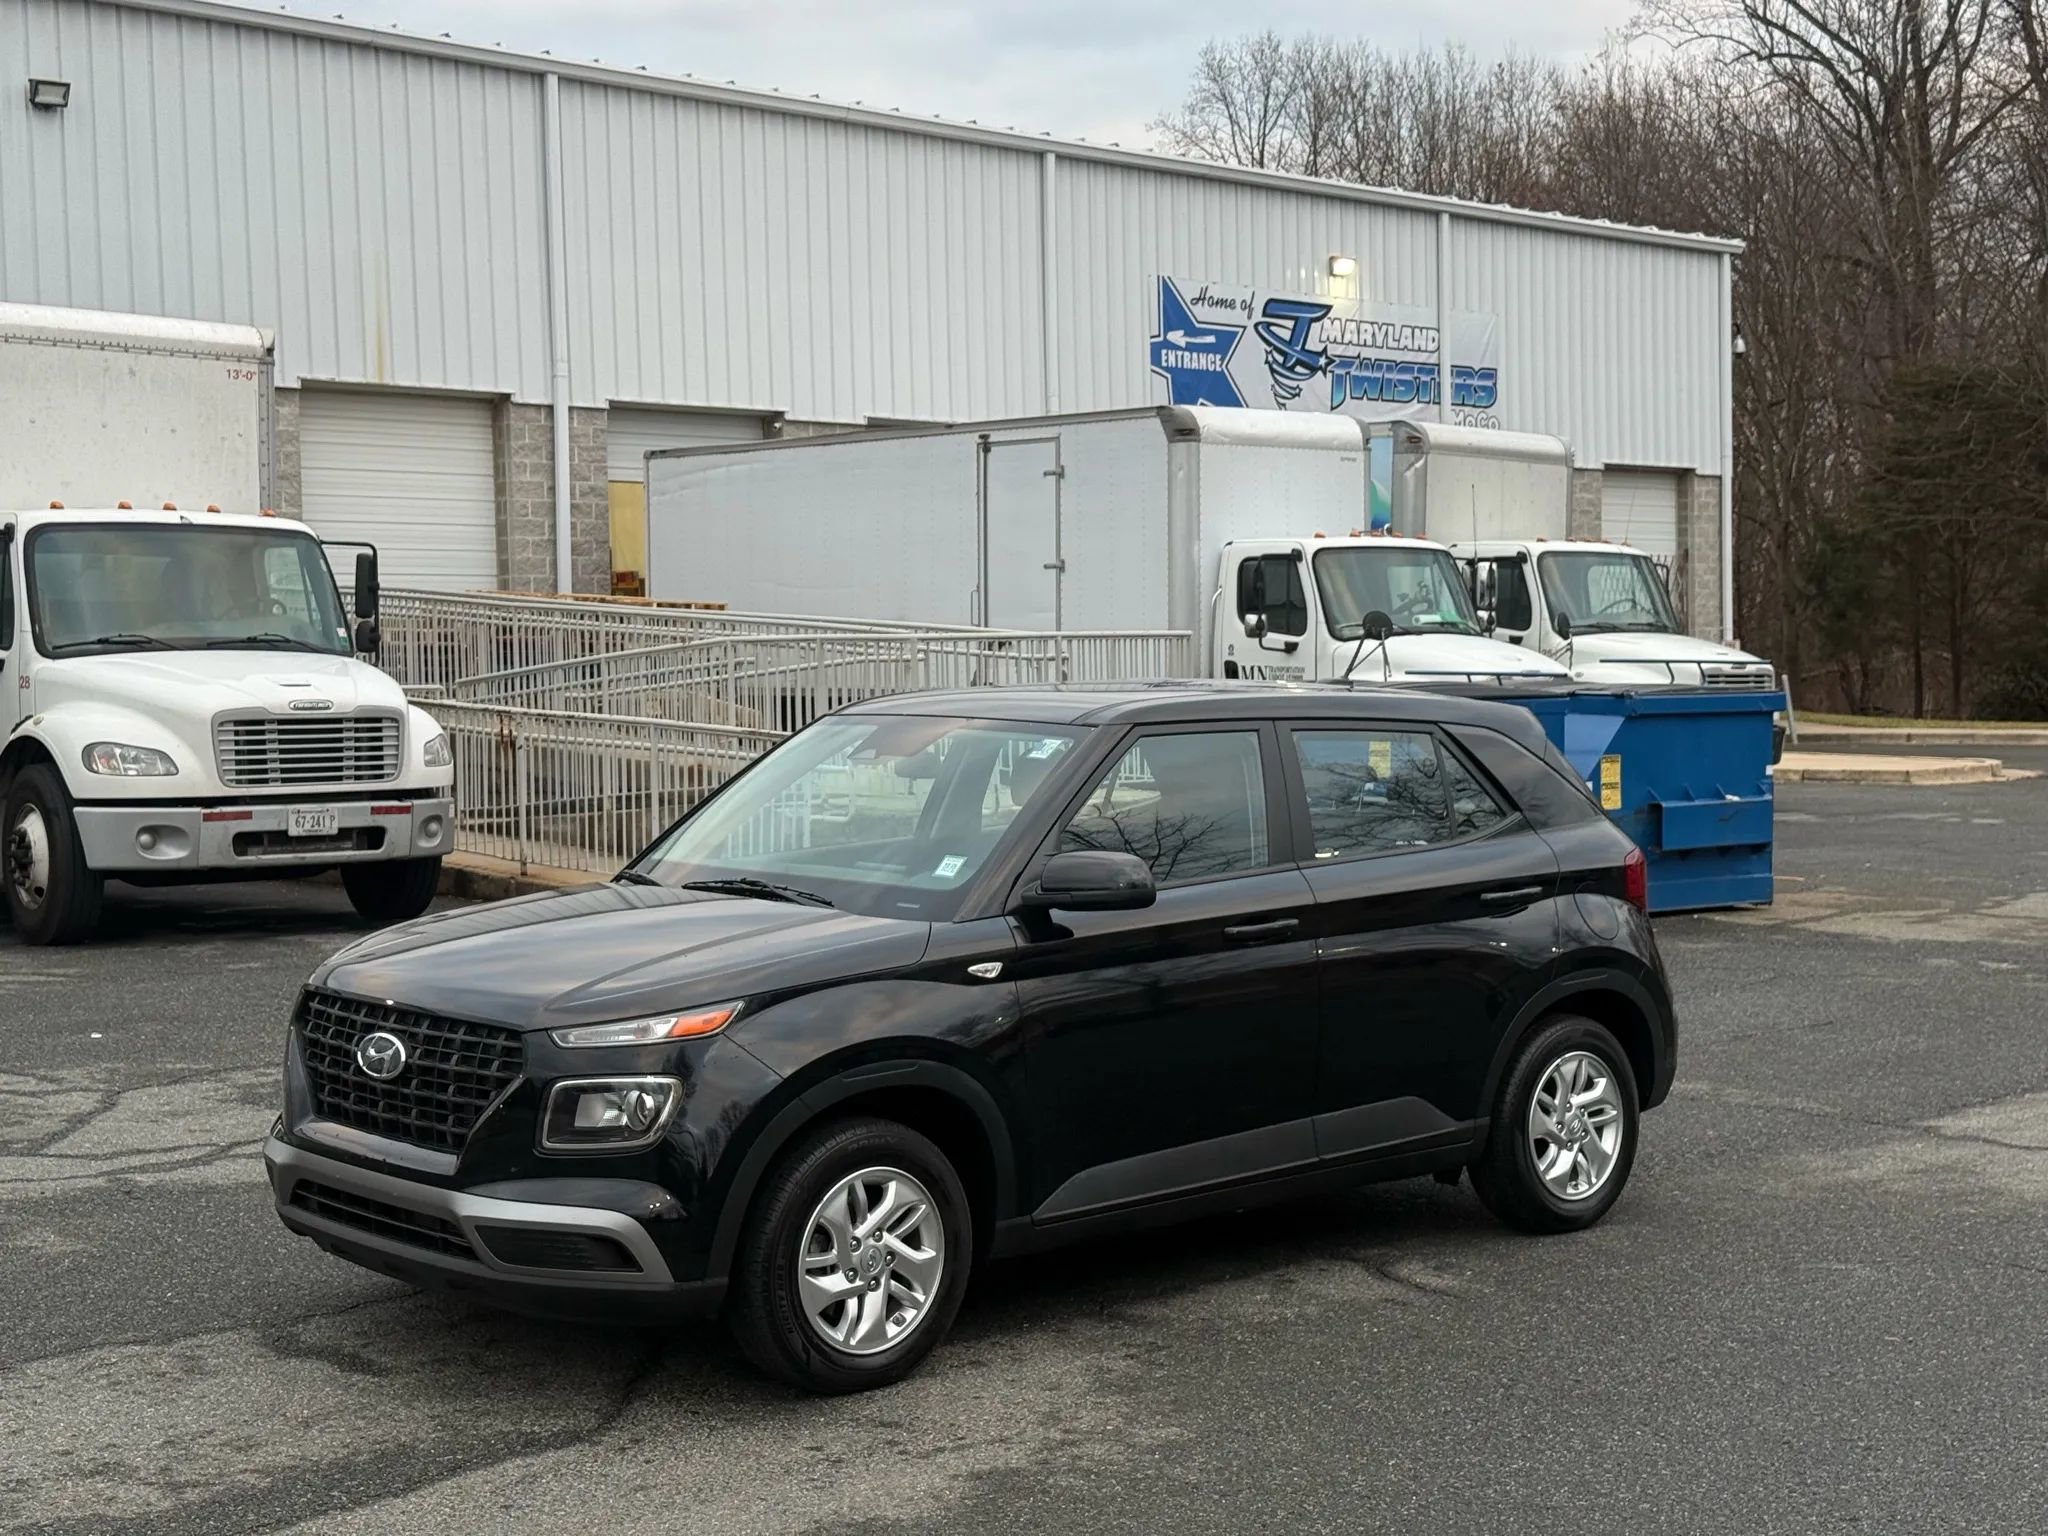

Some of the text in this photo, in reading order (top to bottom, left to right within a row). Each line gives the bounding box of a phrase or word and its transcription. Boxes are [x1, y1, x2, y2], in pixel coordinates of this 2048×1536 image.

[1190, 285, 1255, 321] Home of
[1319, 317, 1440, 353] MARYLAND
[1160, 348, 1223, 372] ENTRANCE
